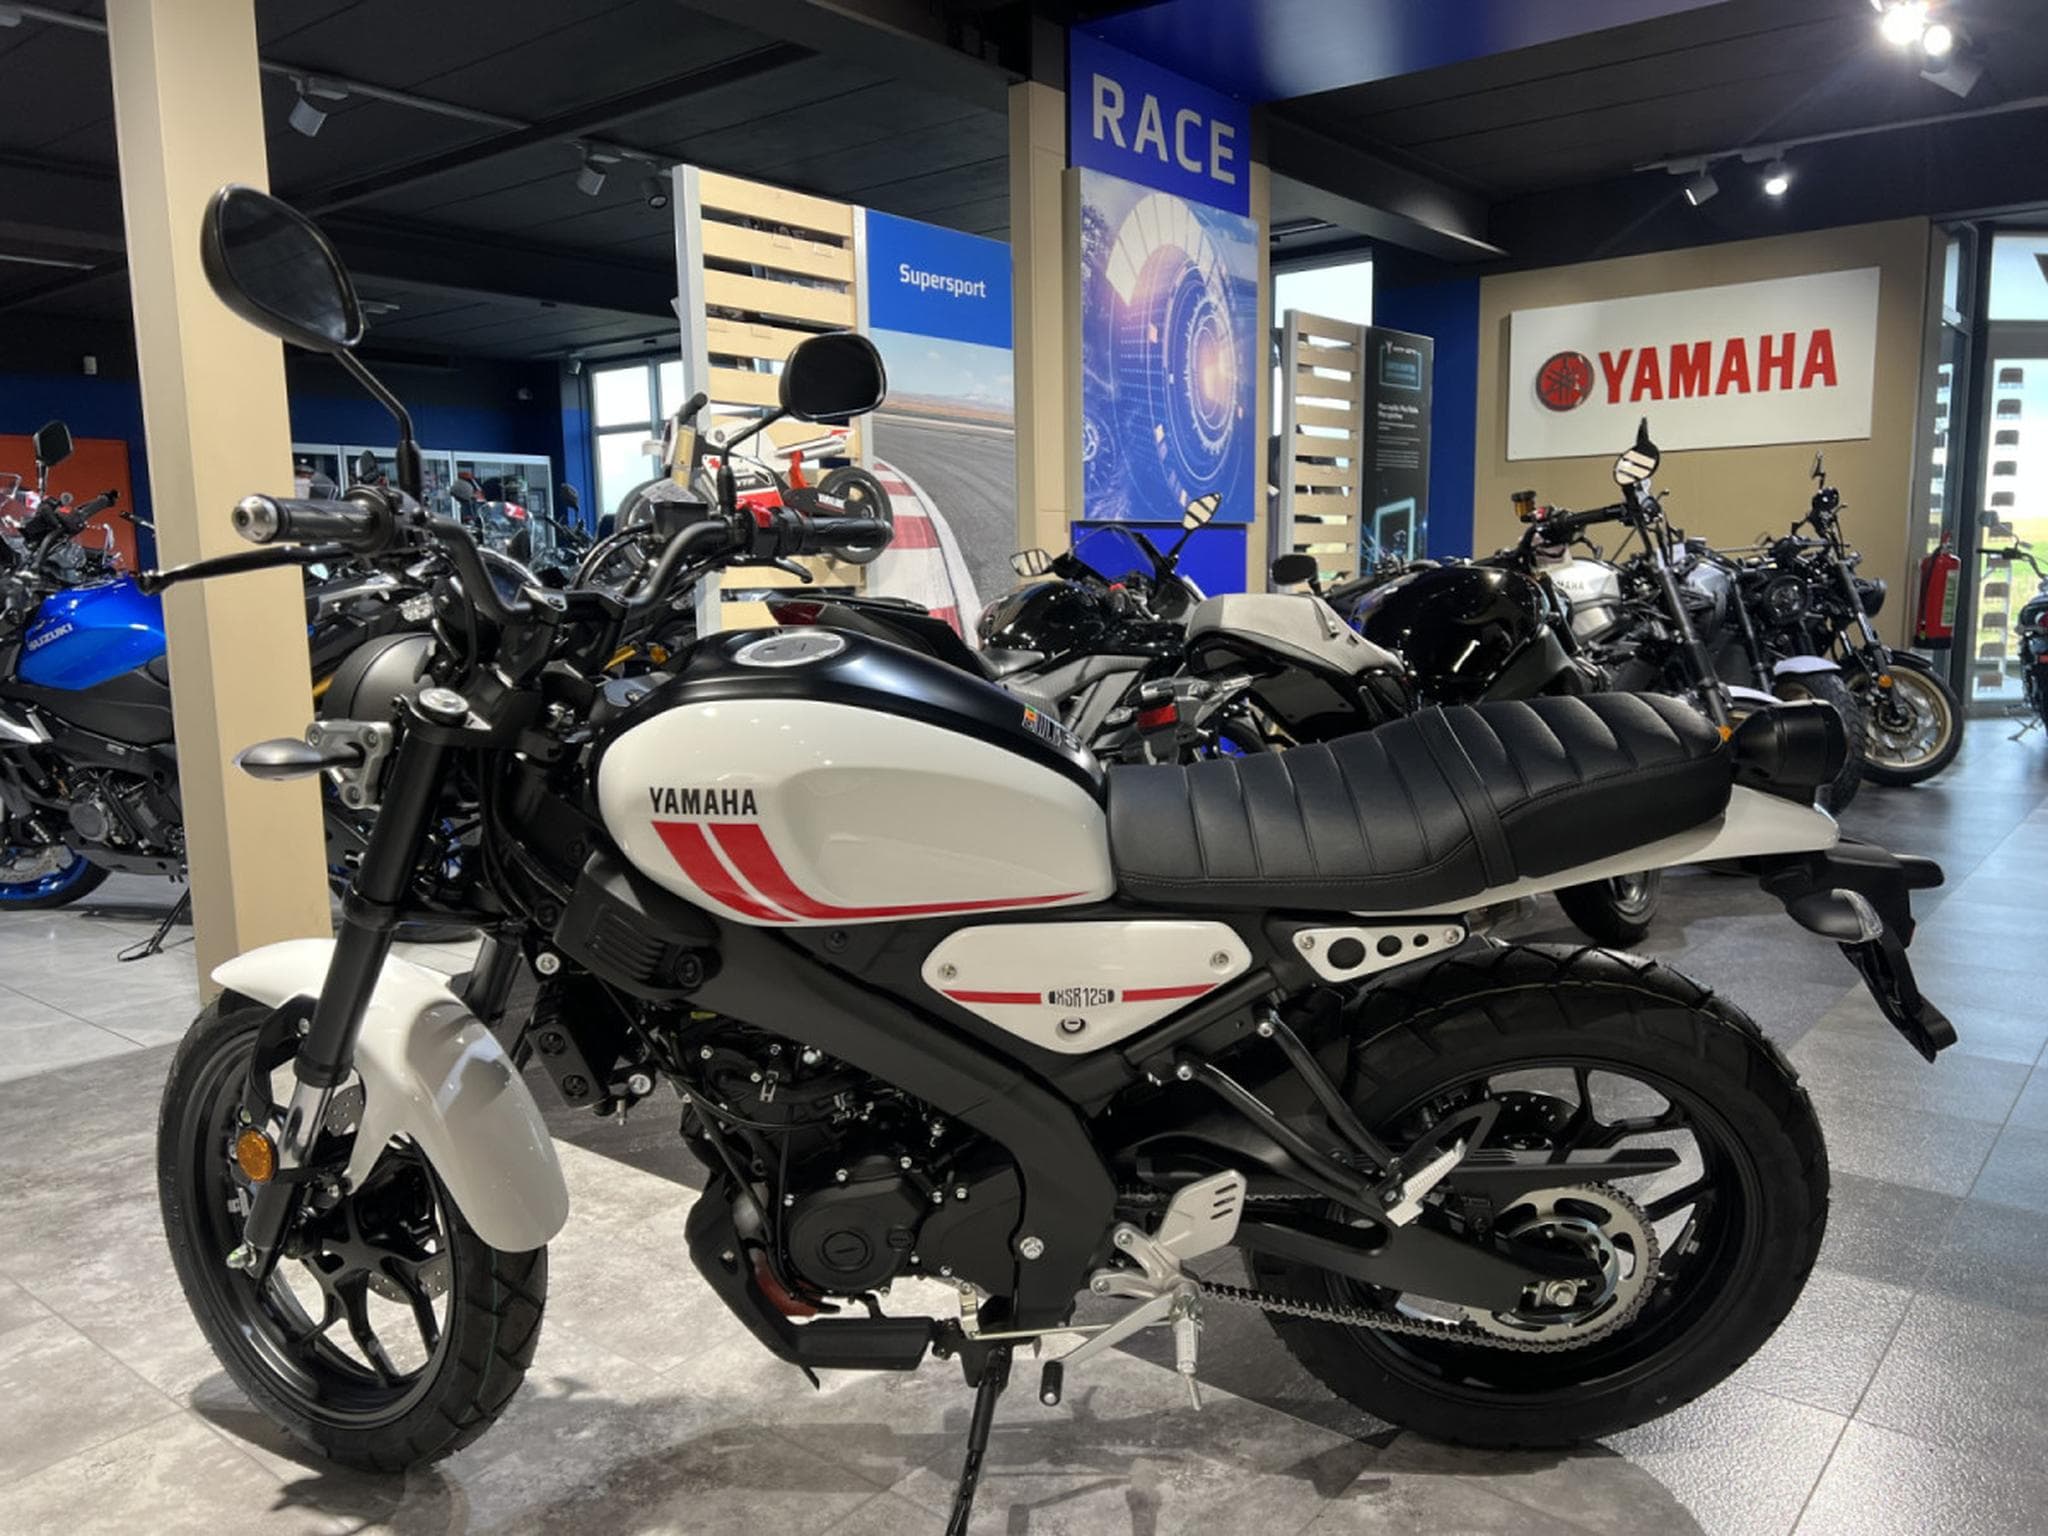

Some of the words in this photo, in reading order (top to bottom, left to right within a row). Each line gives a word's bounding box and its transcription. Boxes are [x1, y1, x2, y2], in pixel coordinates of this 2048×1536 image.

[1093, 72, 1236, 185] RACE
[899, 263, 986, 298] Supersport
[1599, 328, 1838, 405] YAMAHA
[649, 787, 758, 815] YAMAHA
